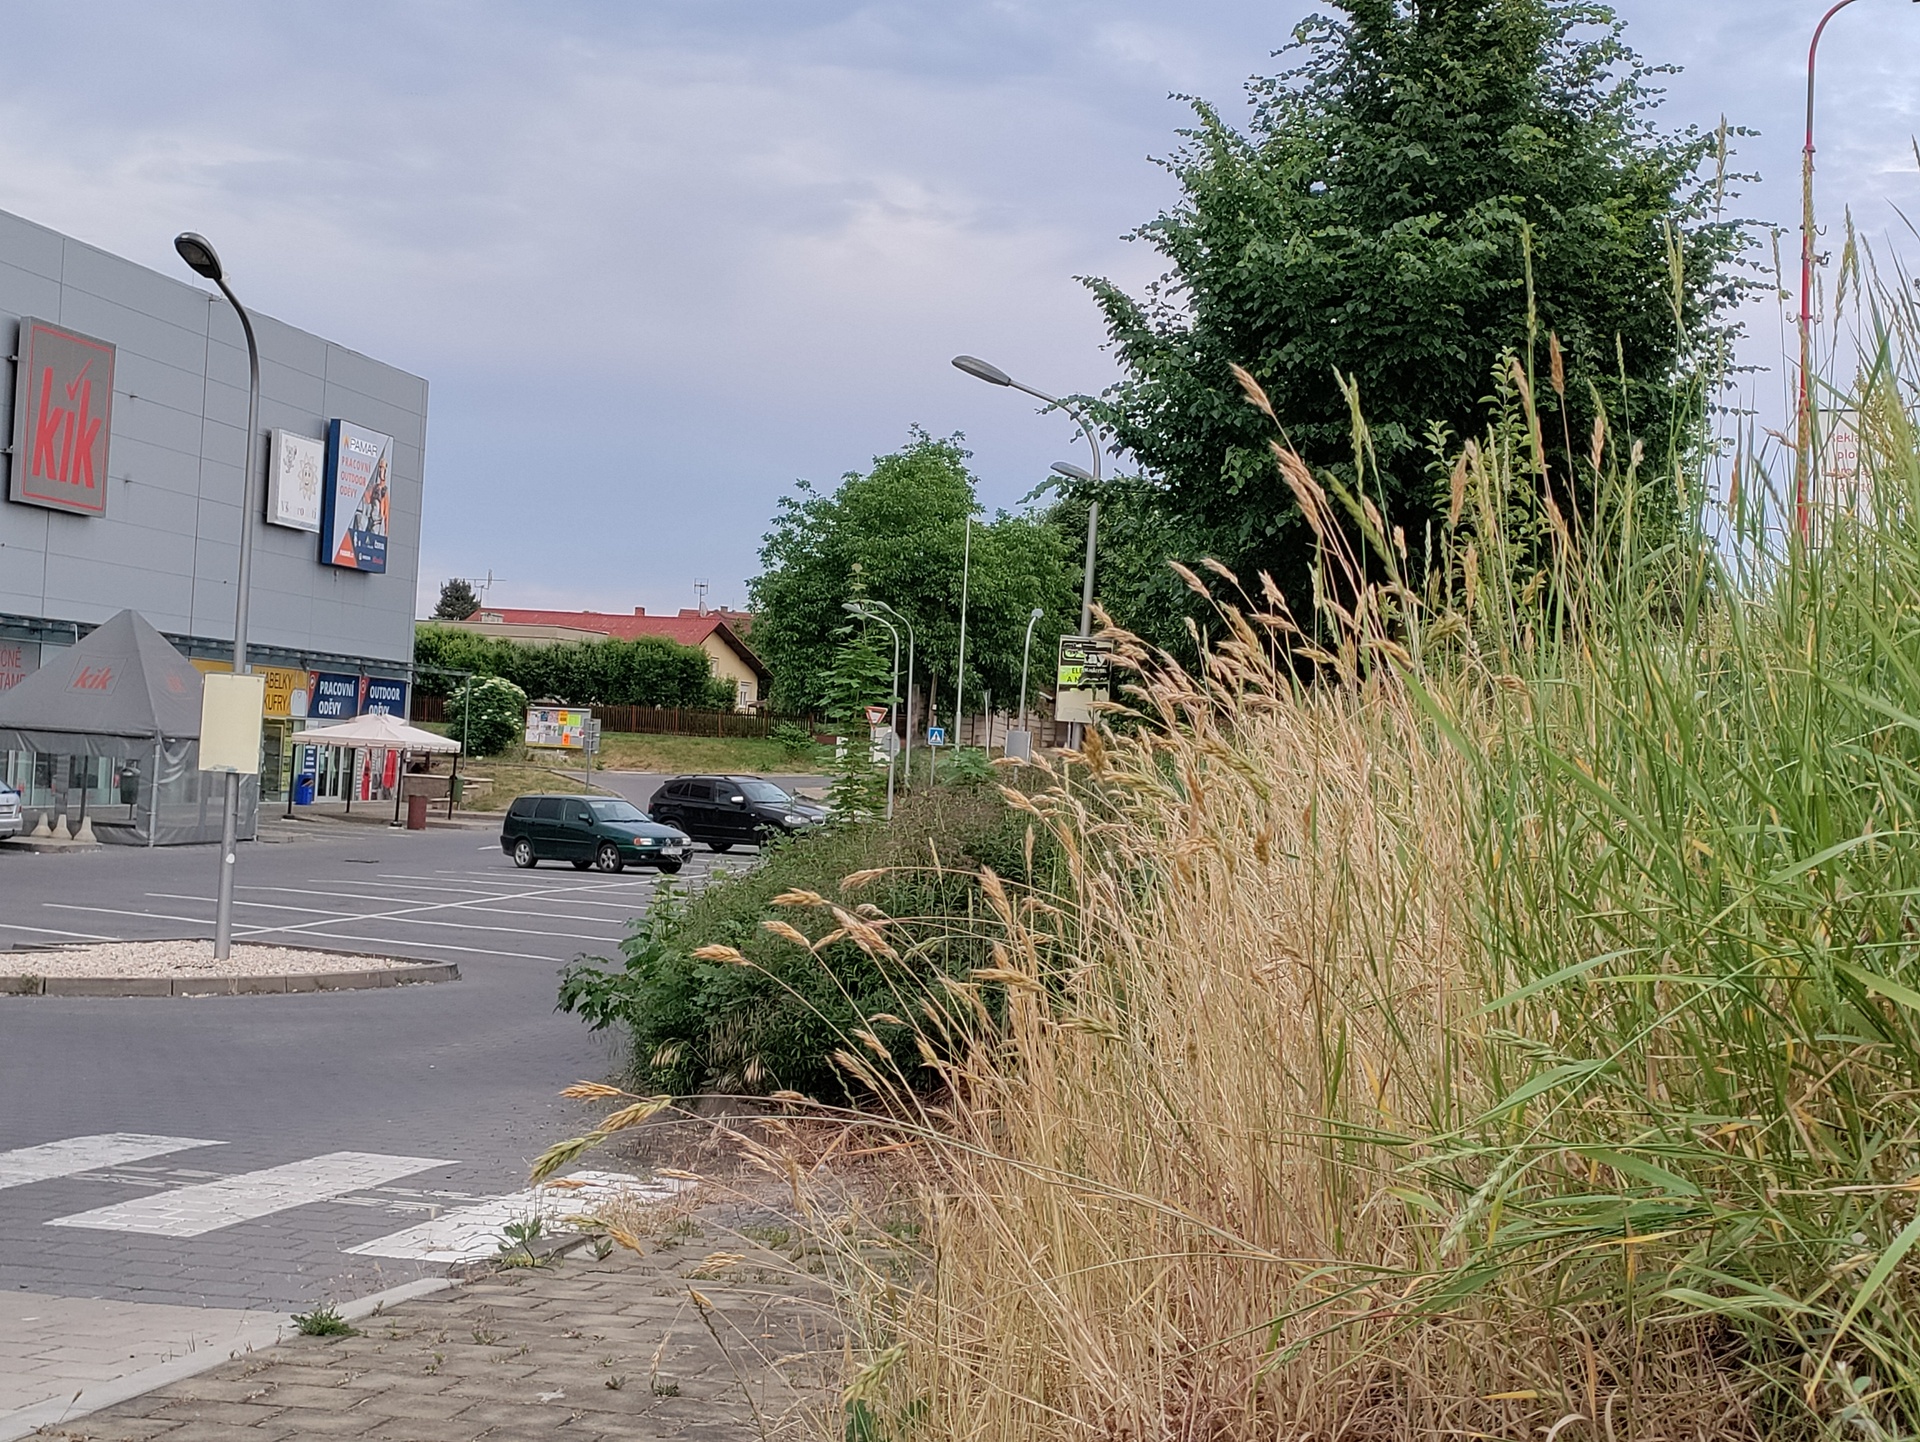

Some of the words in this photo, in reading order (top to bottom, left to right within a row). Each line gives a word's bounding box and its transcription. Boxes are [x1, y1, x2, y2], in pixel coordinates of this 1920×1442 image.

[31, 359, 102, 490] kik
[350, 438, 378, 457] PAMAR
[341, 455, 371, 474] PRACOVNÍ
[340, 471, 367, 487] OUTDOOR
[340, 485, 357, 498] ODĚVY
[73, 665, 114, 690] kik
[320, 680, 355, 697] PRACOVNÍ
[369, 686, 400, 700] OUTDOOR
[318, 698, 341, 715] ODĚVY
[368, 702, 390, 716] ODĚVY
